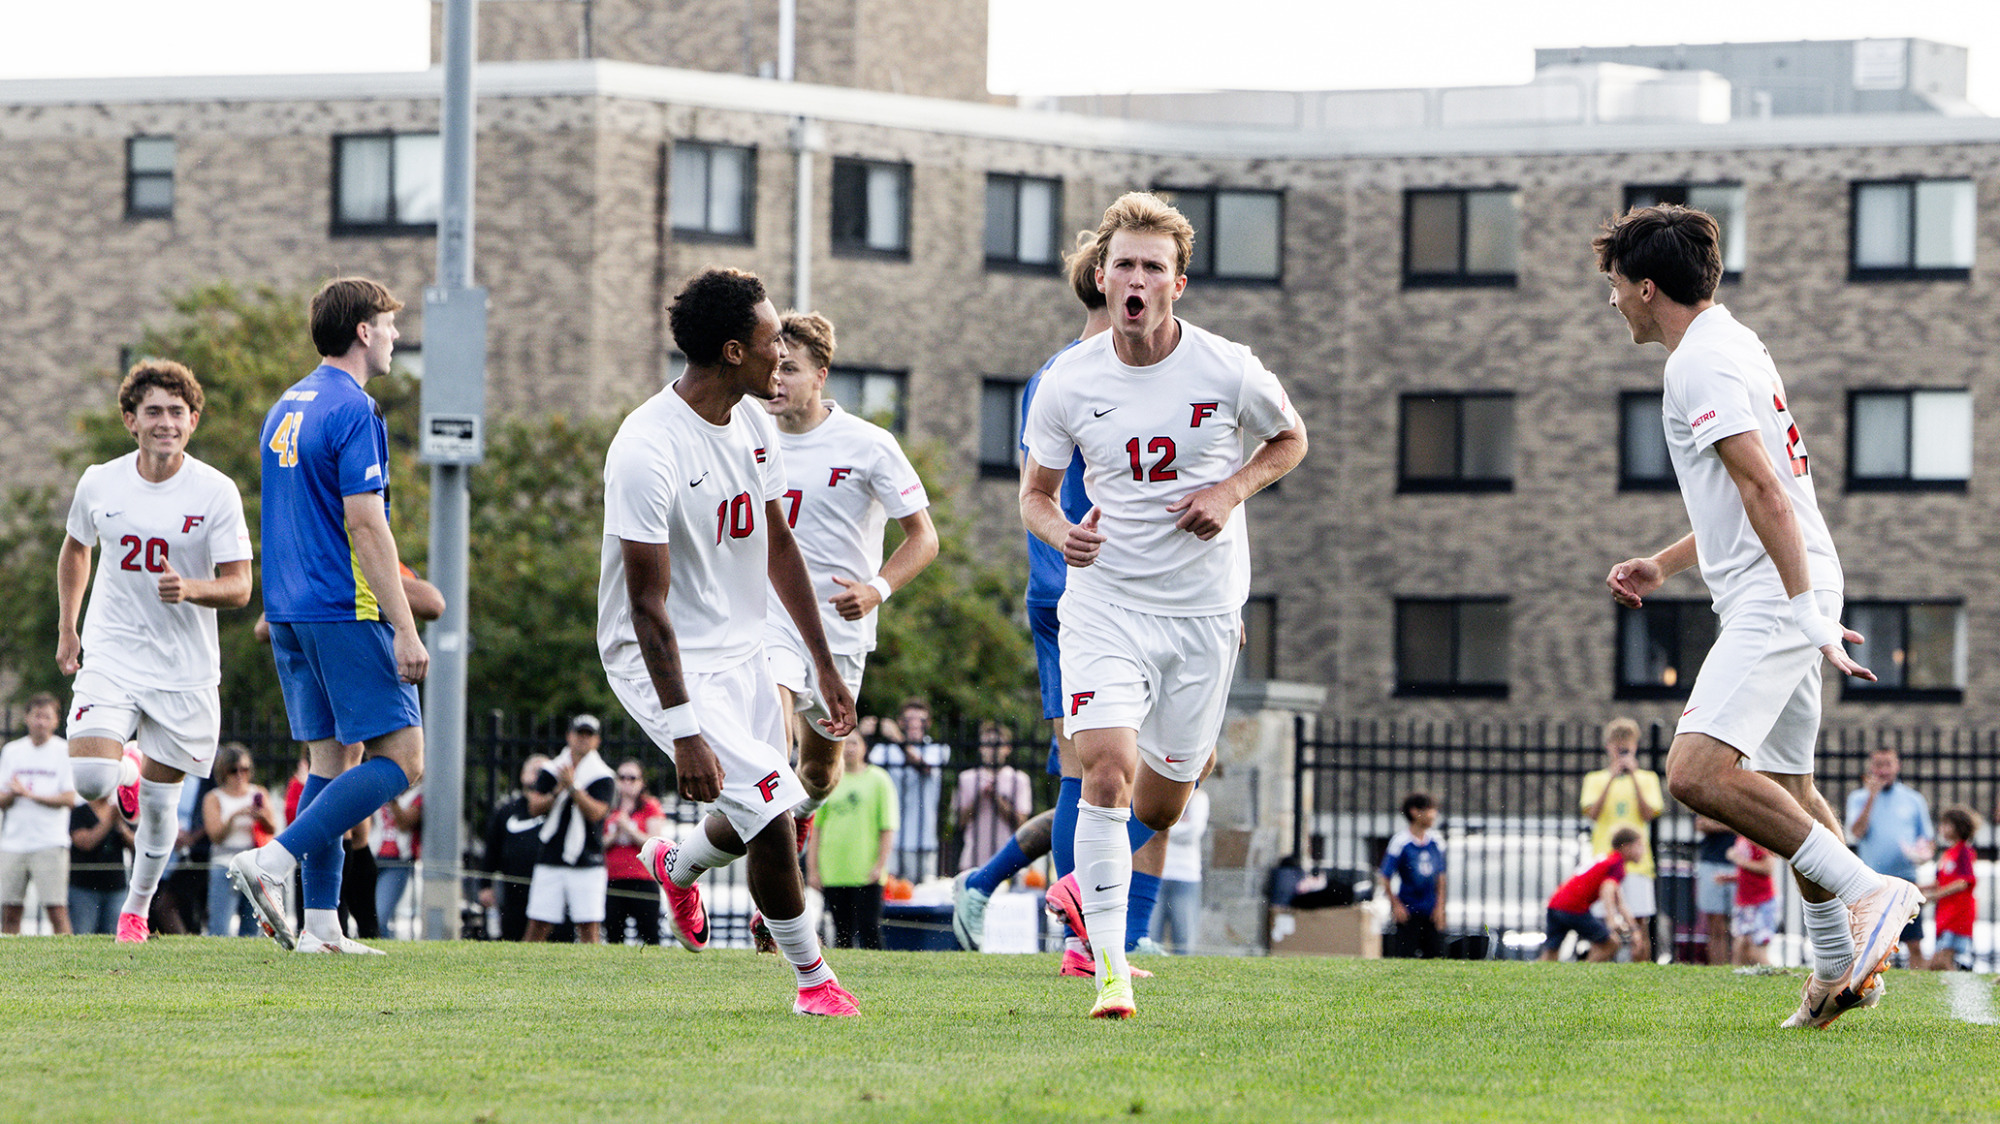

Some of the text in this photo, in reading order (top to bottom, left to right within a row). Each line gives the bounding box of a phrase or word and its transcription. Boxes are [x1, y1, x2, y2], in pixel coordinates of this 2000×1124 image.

[1189, 402, 1218, 428] F
[1691, 410, 1716, 429] METRO
[268, 411, 304, 468] 43
[1125, 436, 1178, 482] 12
[828, 467, 852, 487] F
[181, 514, 205, 534] F
[716, 490, 755, 546] 10
[120, 534, 169, 573] 20
[1070, 690, 1096, 717] F
[752, 769, 781, 804] F
